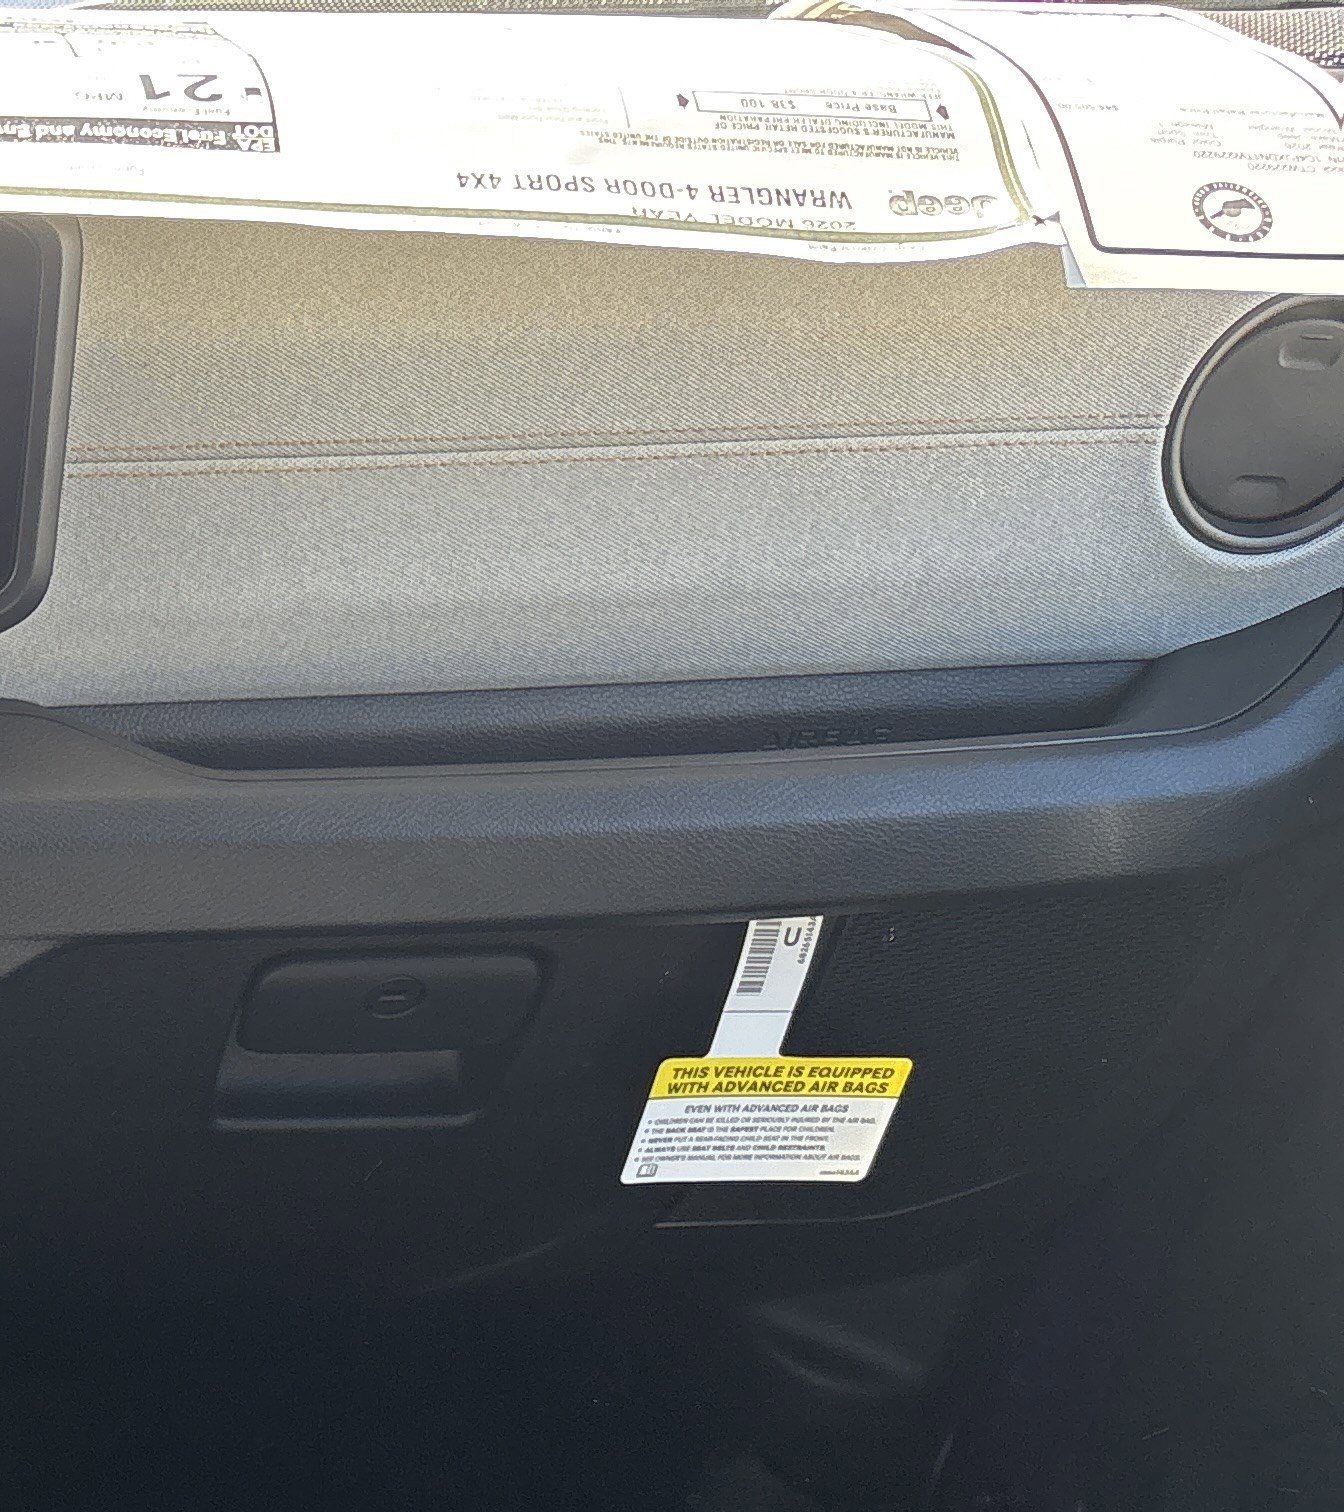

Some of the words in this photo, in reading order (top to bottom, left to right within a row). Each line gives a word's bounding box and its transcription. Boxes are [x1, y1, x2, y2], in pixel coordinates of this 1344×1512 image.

[138, 74, 224, 102] 21
[865, 102, 897, 115] Base
[35, 124, 75, 140] and
[80, 122, 175, 142] Economy
[179, 128, 226, 145] Fuel
[233, 125, 273, 138] DOT
[237, 138, 274, 152] EPA
[455, 171, 502, 191] 4X4
[512, 173, 595, 193] SPORT
[603, 178, 699, 200] 4-DOOR
[708, 185, 853, 210] WRANGLER
[888, 190, 998, 219] Jeep
[784, 926, 802, 947] U
[672, 1066, 711, 1080] THIS
[714, 1065, 783, 1079] VEHICLE
[787, 1065, 804, 1078] IS
[807, 1066, 895, 1080] EQUIPPED
[667, 1081, 709, 1095] WITH
[712, 1080, 805, 1094] ADVANCED
[808, 1080, 839, 1093] AIR
[842, 1080, 889, 1094] BAGS
[684, 1104, 712, 1114] EVEN
[714, 1103, 742, 1113] WITH
[741, 1103, 800, 1113] ADVANCED
[800, 1103, 819, 1113] AIR
[820, 1103, 850, 1113] BAGS
